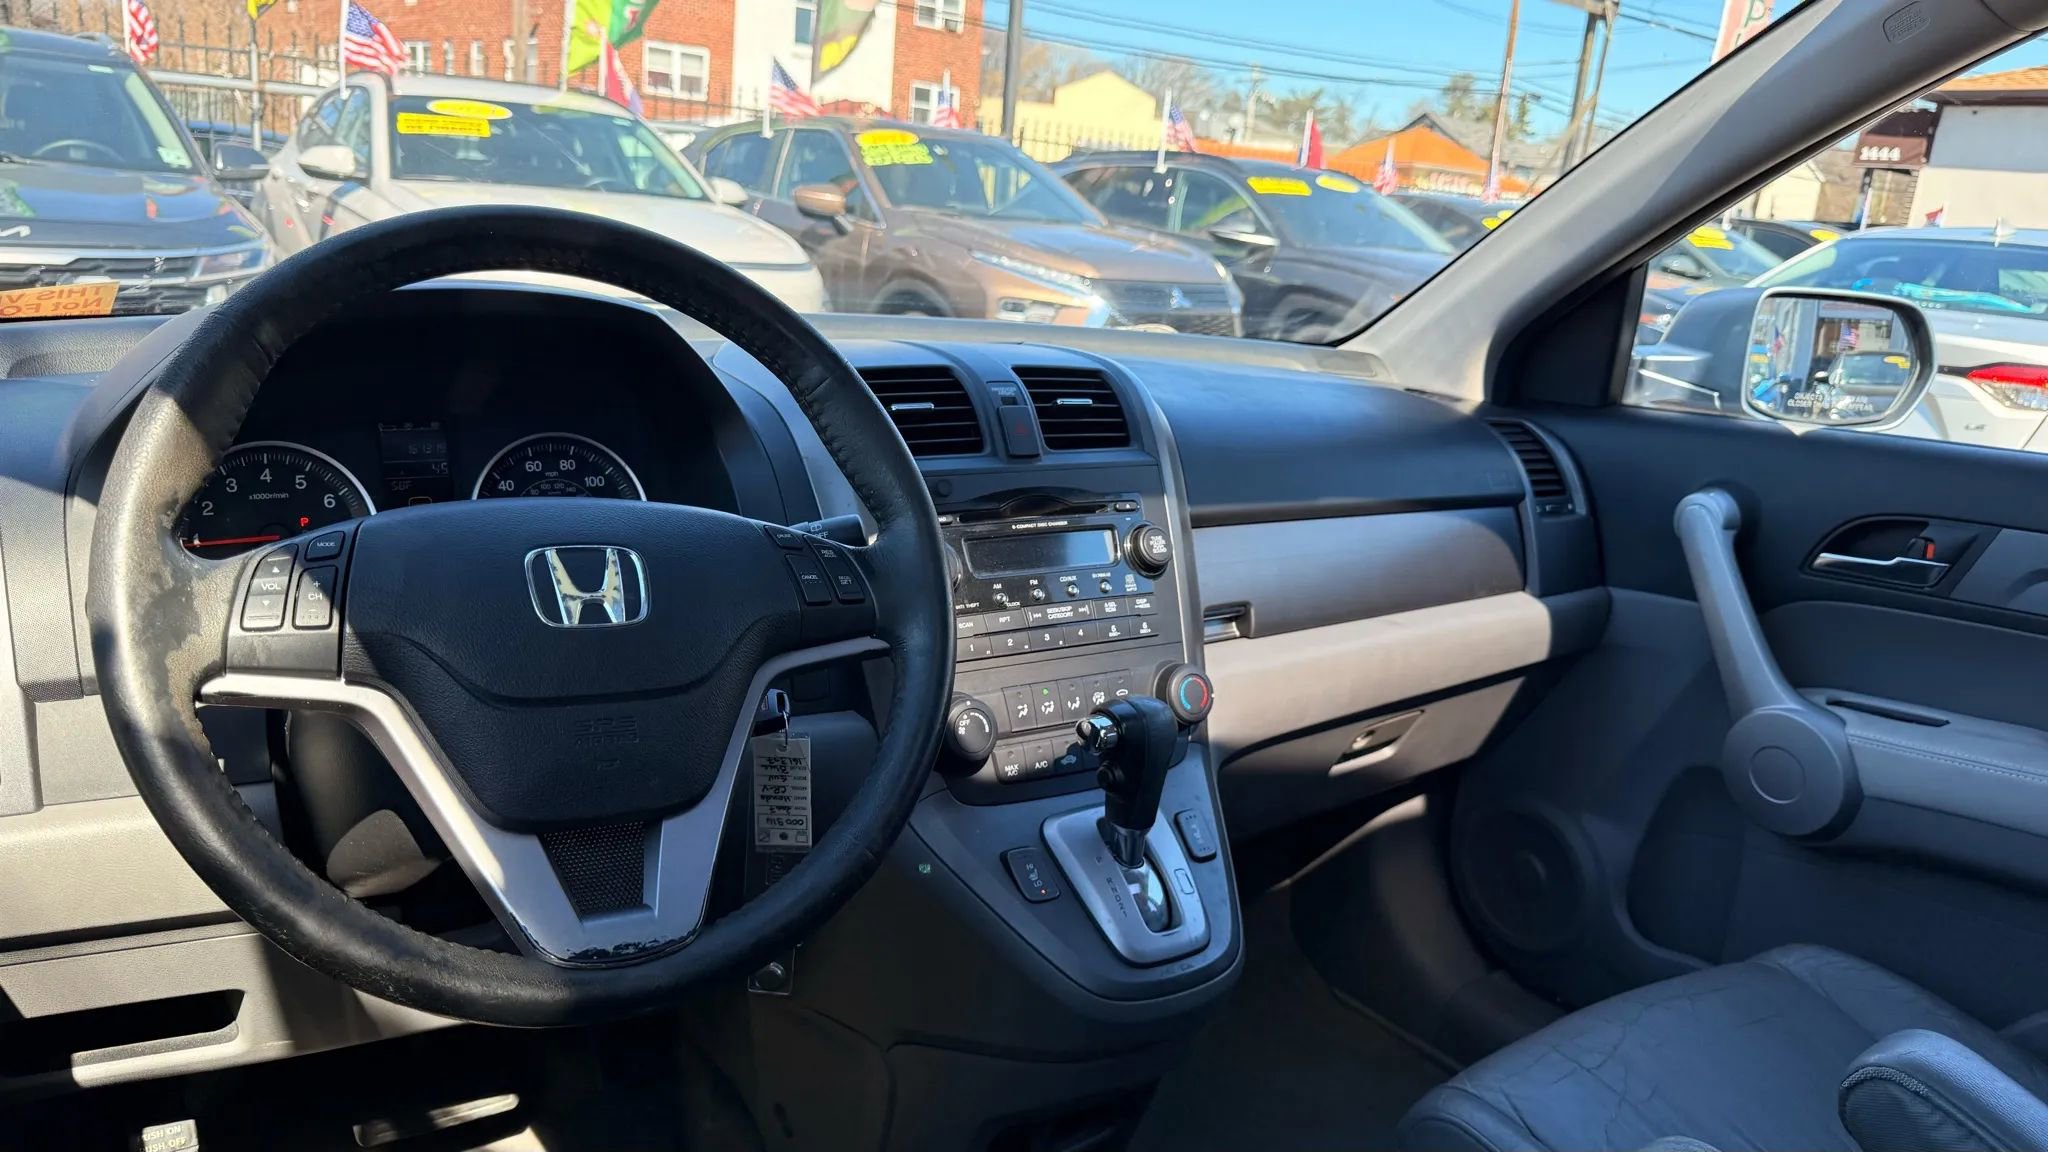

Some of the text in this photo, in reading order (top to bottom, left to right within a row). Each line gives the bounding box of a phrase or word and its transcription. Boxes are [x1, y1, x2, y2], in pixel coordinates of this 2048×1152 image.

[1859, 145, 1901, 161] 1444
[525, 460, 542, 472] 60
[560, 459, 576, 471] 80
[260, 468, 272, 483] 4
[226, 478, 238, 493] 3
[295, 475, 307, 490] 5
[499, 479, 515, 492] 40
[584, 475, 605, 488] 100
[323, 493, 336, 509] 6
[201, 501, 215, 516] 2
[300, 517, 311, 528] P
[308, 592, 323, 600] CH
[999, 615, 1011, 623] RPT
[958, 621, 974, 629] SCAN
[1142, 621, 1148, 629] 6
[1044, 633, 1050, 641] 3
[1078, 629, 1084, 637] 4
[1007, 638, 1014, 647] 2
[969, 644, 975, 652] 1
[959, 718, 971, 726] OFF
[1004, 763, 1019, 772] MAX
[1035, 760, 1048, 769] A/C
[1007, 769, 1019, 777] A/C
[761, 784, 787, 794] CR-V
[142, 1124, 182, 1141] USH ON
[168, 1136, 187, 1148] OFF
